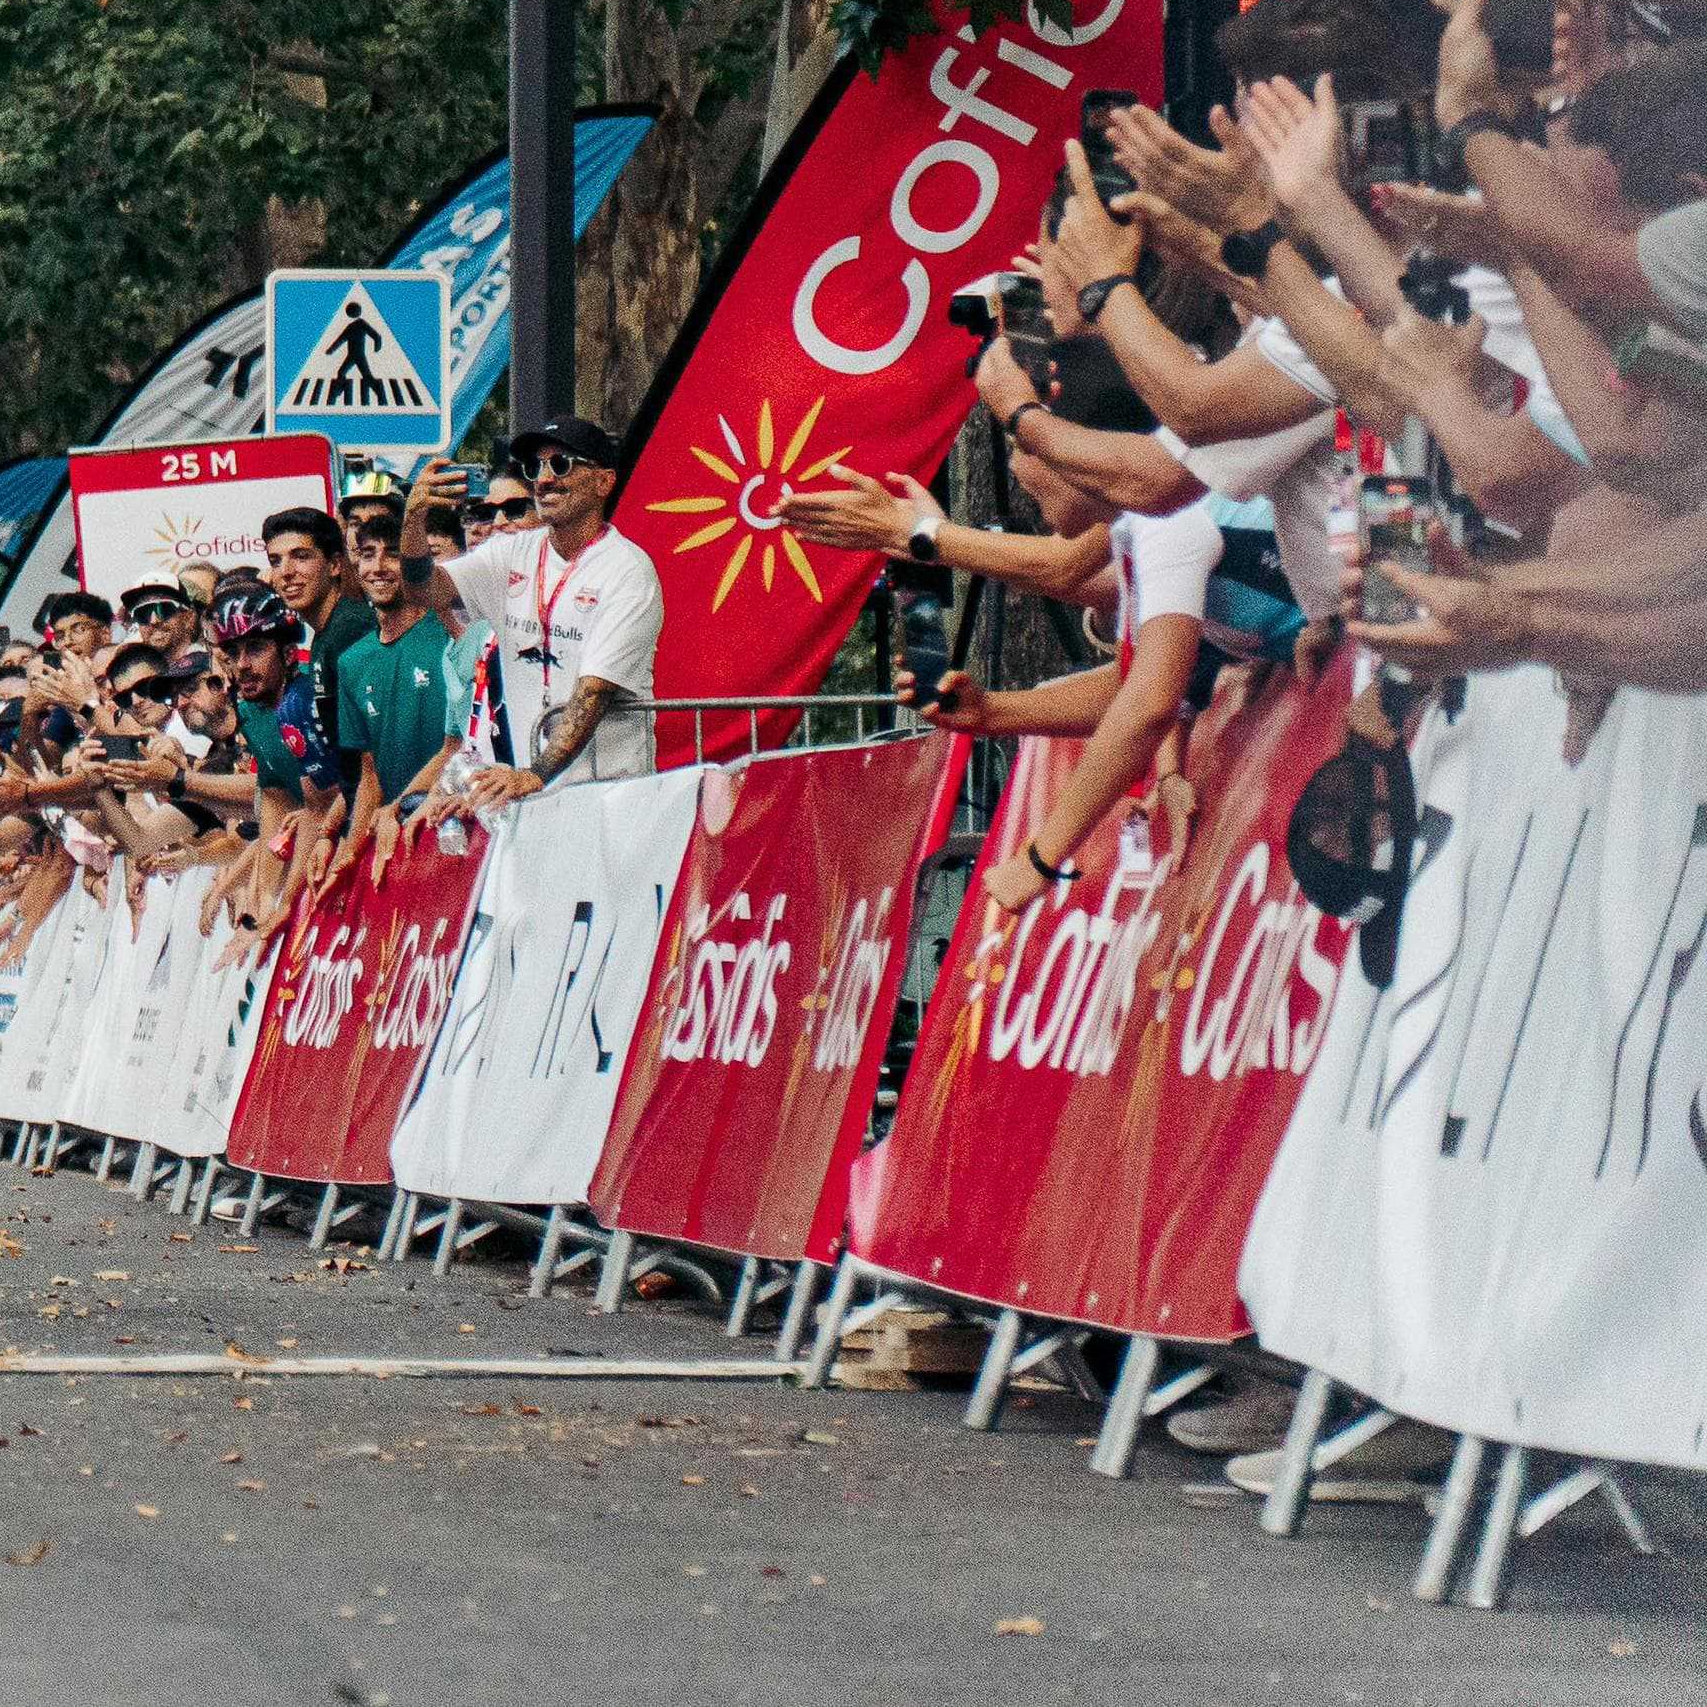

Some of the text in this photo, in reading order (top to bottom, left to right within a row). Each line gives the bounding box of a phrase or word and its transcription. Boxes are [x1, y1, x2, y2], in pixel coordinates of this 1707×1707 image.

[160, 449, 238, 482] 25 M
[174, 533, 269, 559] Cofidis
